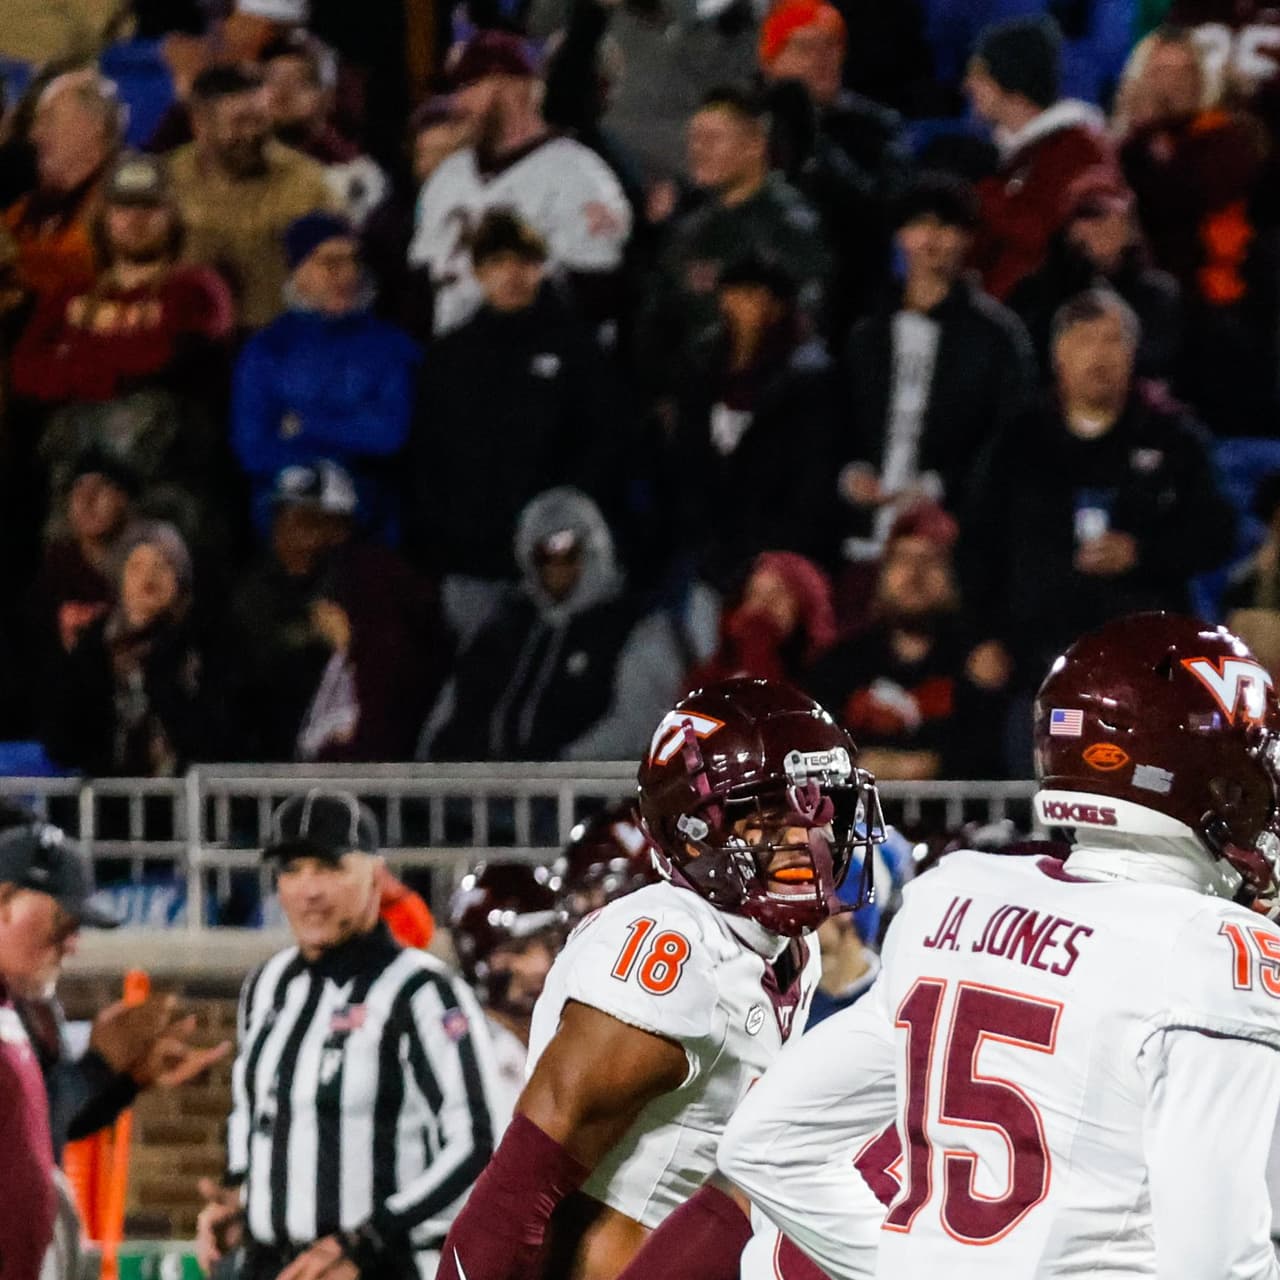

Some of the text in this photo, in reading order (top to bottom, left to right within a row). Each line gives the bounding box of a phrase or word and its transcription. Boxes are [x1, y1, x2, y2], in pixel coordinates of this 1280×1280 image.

[1181, 656, 1274, 727] VT
[611, 916, 692, 996] 18
[922, 898, 1093, 977] JA. JONES
[881, 975, 1065, 1248] 15
